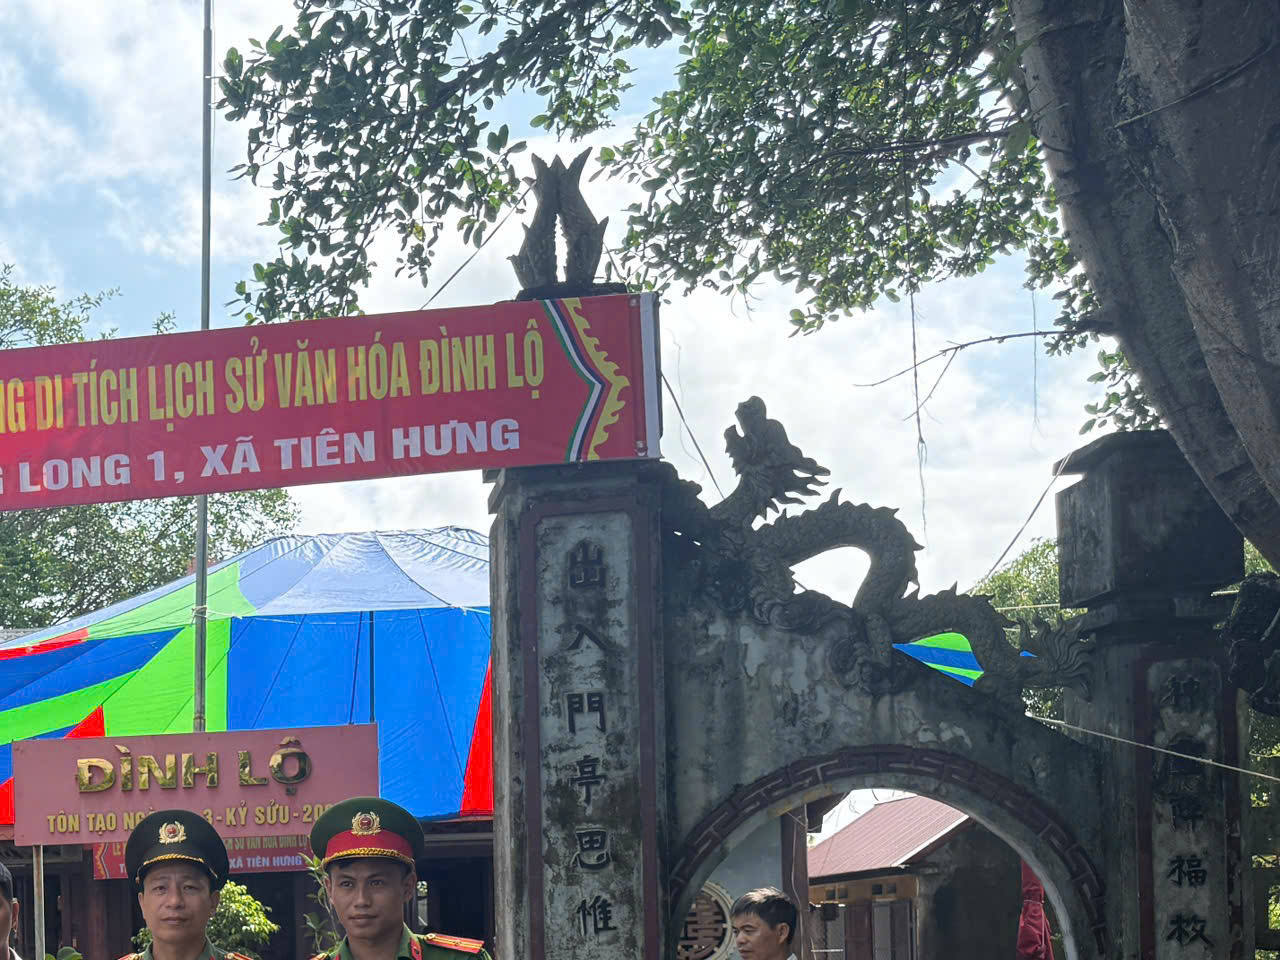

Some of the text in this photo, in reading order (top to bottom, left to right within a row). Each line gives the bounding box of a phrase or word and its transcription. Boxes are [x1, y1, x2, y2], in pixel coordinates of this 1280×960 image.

[35, 374, 64, 431] DI
[72, 359, 139, 428] TÍCH
[148, 360, 215, 432] LỊCH
[225, 336, 268, 413] SỬ
[273, 338, 337, 408] VĂN
[346, 331, 411, 402] HÓA
[419, 326, 497, 395] ĐÌNH
[506, 319, 544, 399] LỘ
[20, 453, 131, 493] LONG
[147, 451, 185, 484] 1,
[200, 435, 261, 478] XÃ
[273, 427, 376, 470] TIÊN
[392, 418, 520, 460] HƯNG
[75, 736, 312, 797] ĐÌNH LỘ
[47, 810, 80, 833] TÔN
[86, 812, 117, 836] TẠO
[123, 806, 154, 831] NG
